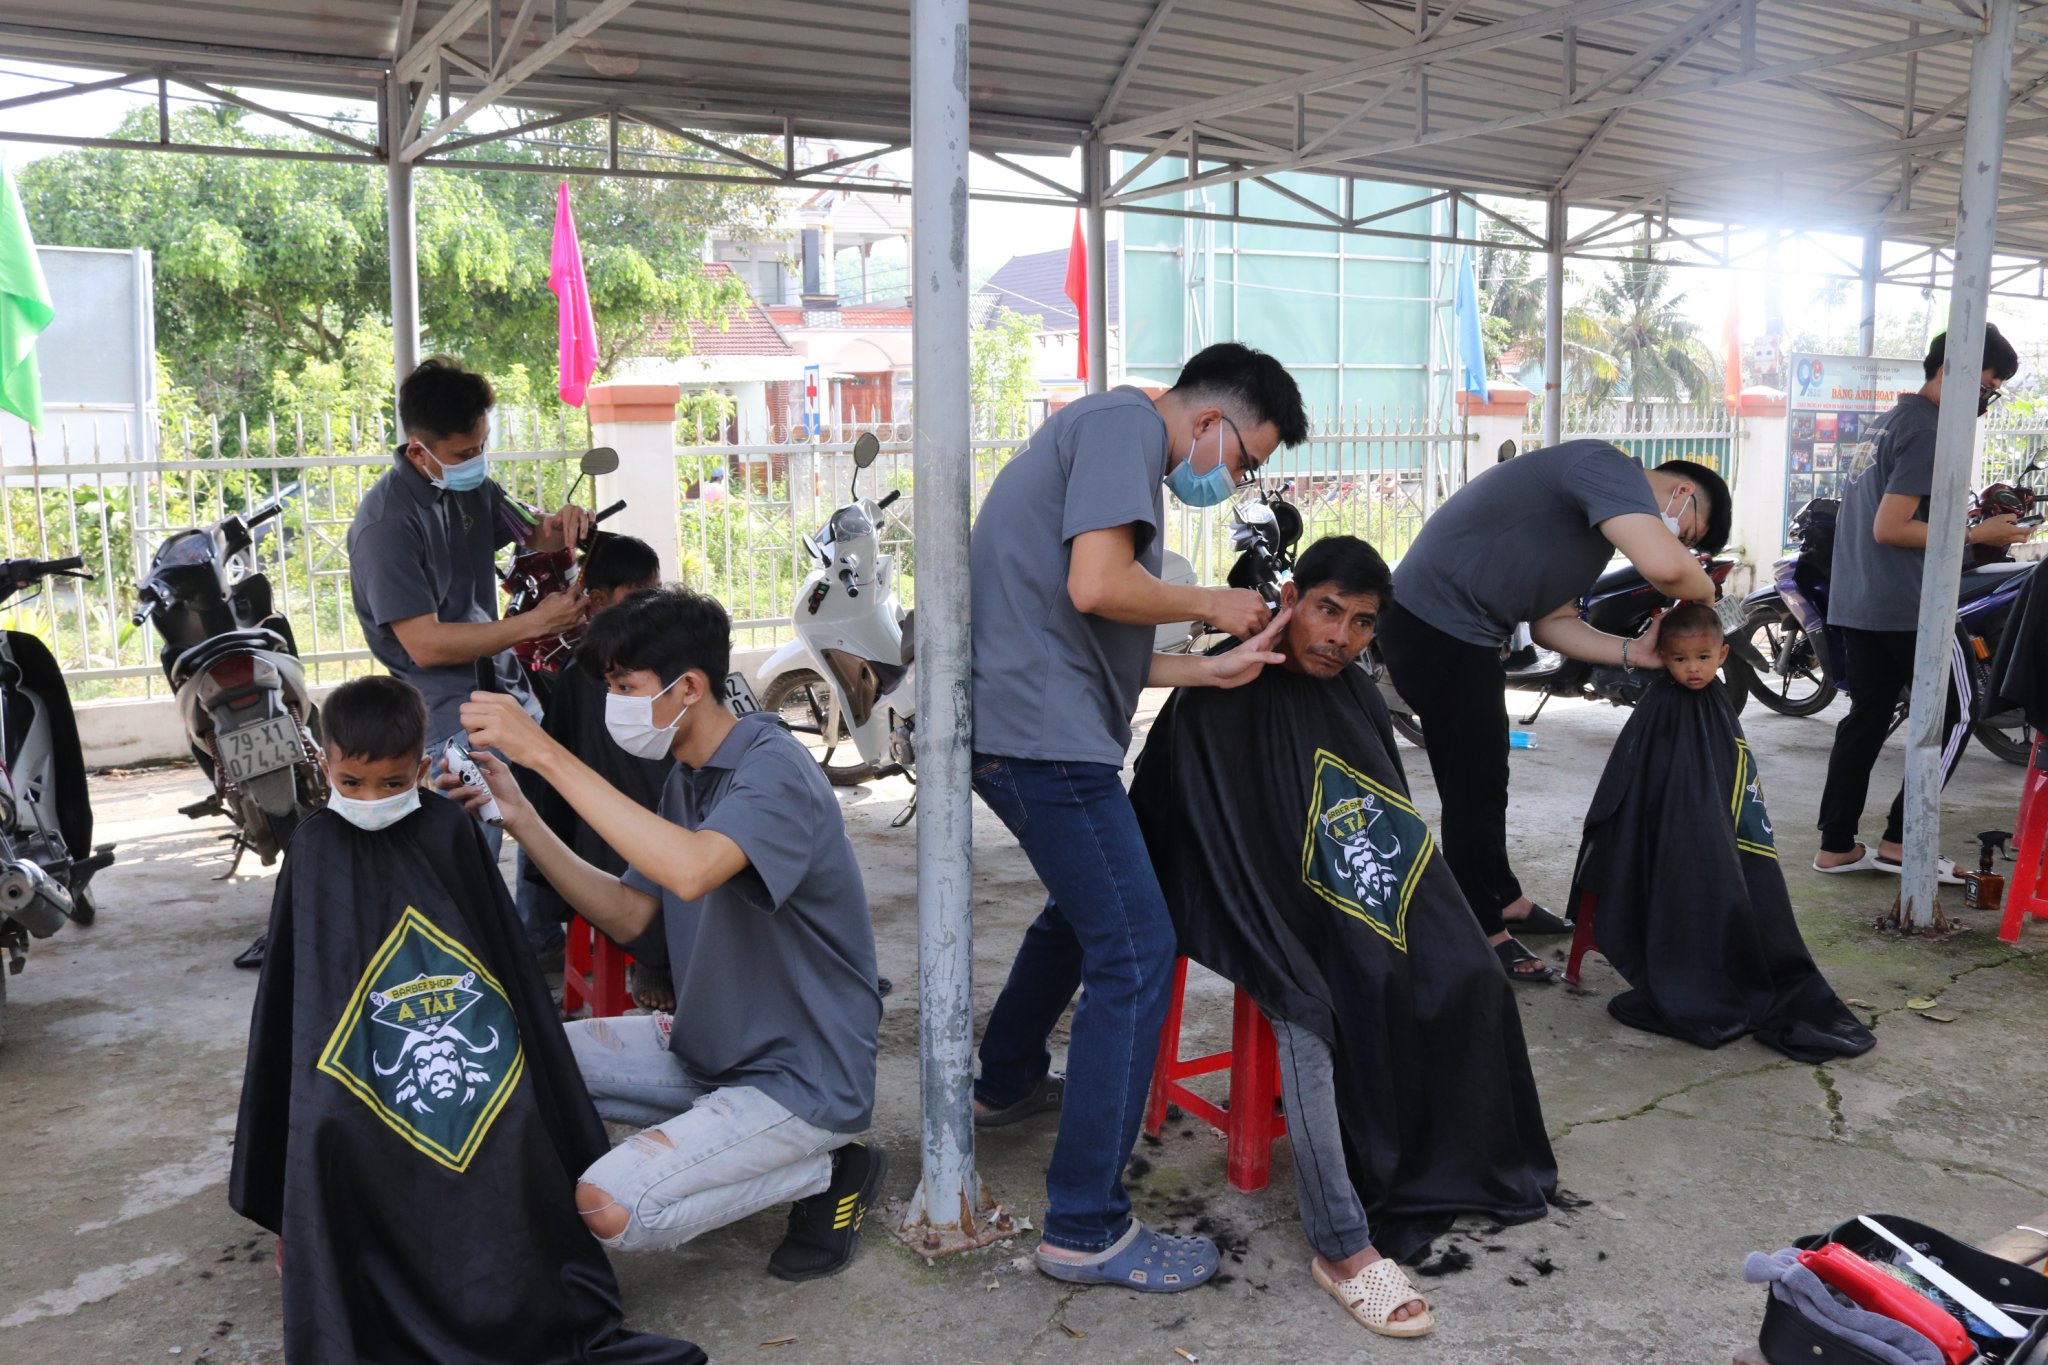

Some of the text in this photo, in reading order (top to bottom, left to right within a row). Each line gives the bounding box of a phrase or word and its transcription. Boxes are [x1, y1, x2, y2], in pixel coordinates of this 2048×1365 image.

[229, 722, 284, 756] 79-X1
[229, 740, 299, 778] 074.43
[1333, 810, 1367, 839] A TÀ
[392, 979, 452, 998] BARBER SHOP
[397, 991, 457, 1022] A TÀI
